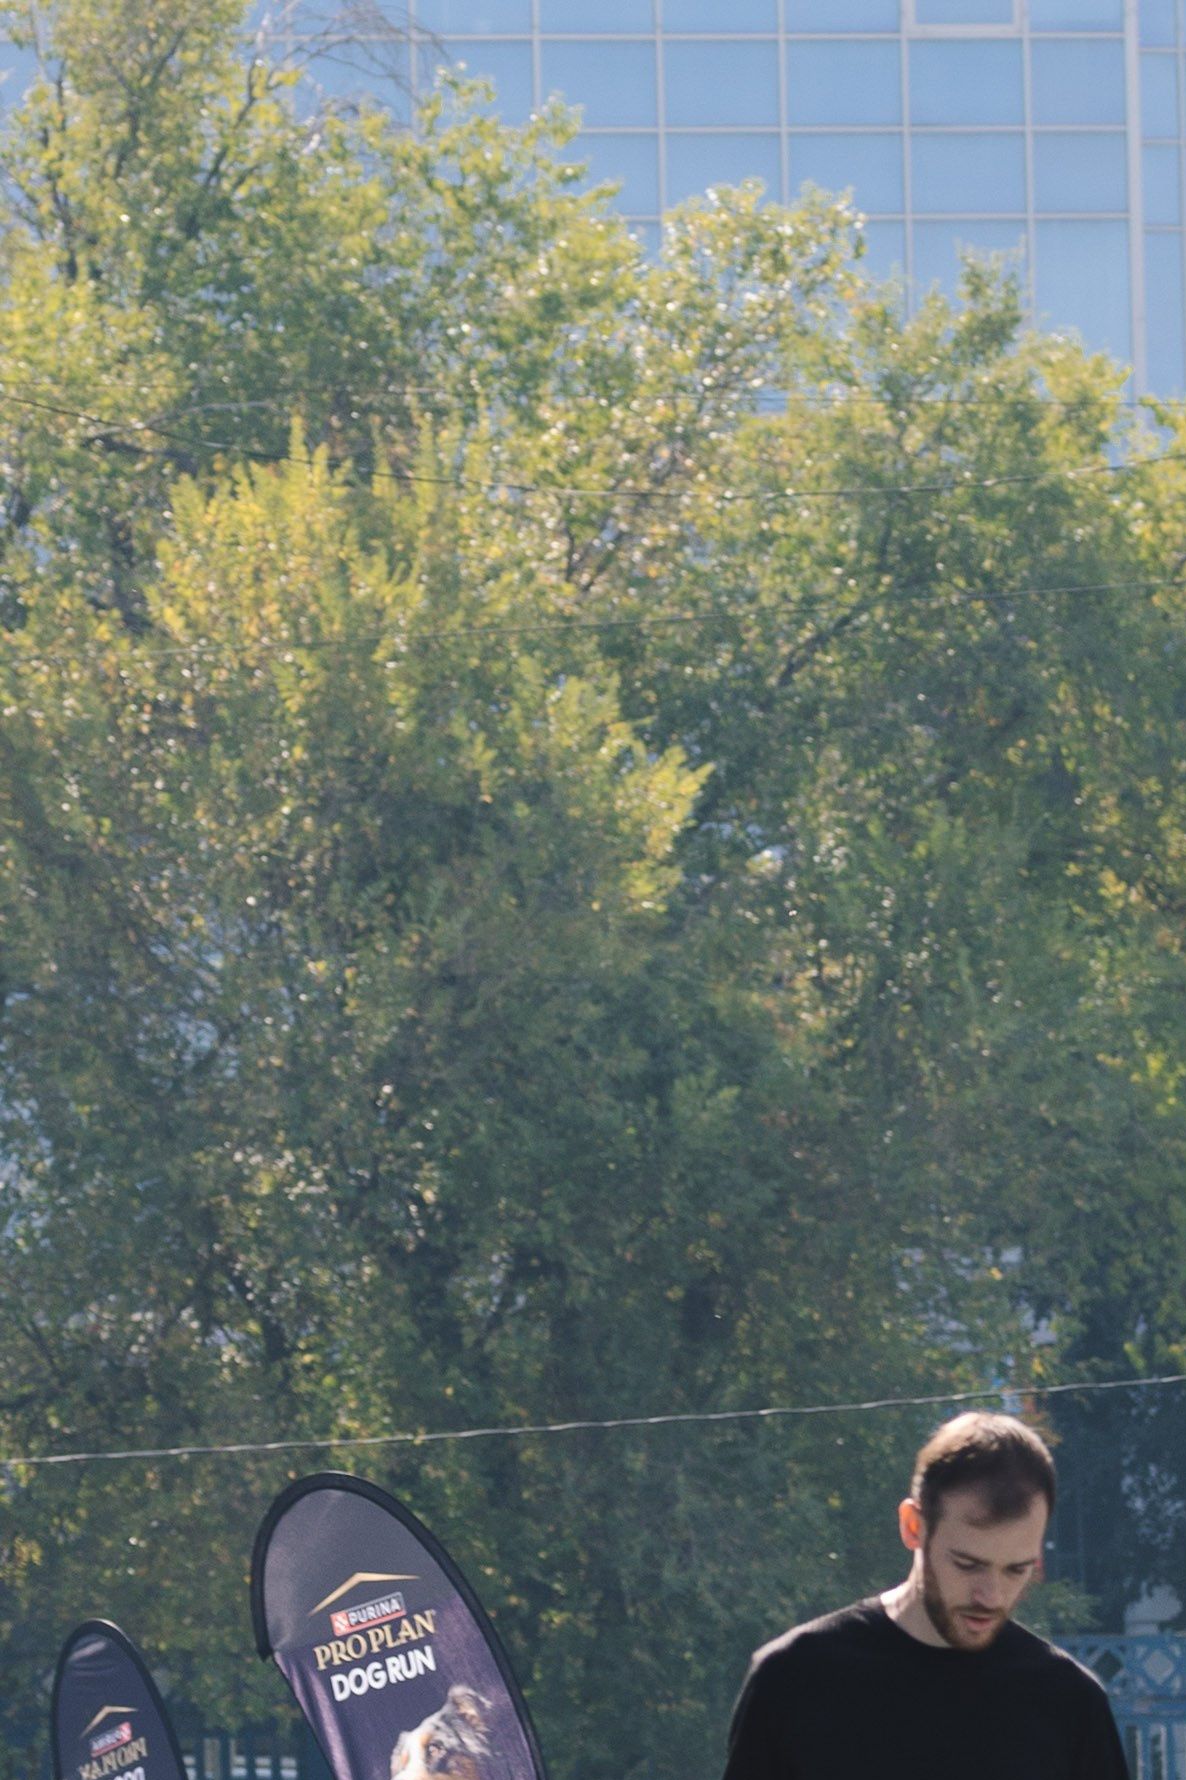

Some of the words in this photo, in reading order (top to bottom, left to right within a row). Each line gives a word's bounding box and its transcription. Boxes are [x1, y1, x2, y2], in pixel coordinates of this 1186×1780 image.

[312, 1633, 368, 1671] PRO
[366, 1609, 437, 1653] PLAN
[347, 1597, 402, 1626] PURINA
[330, 1661, 388, 1702] DOG
[384, 1645, 437, 1684] RUN
